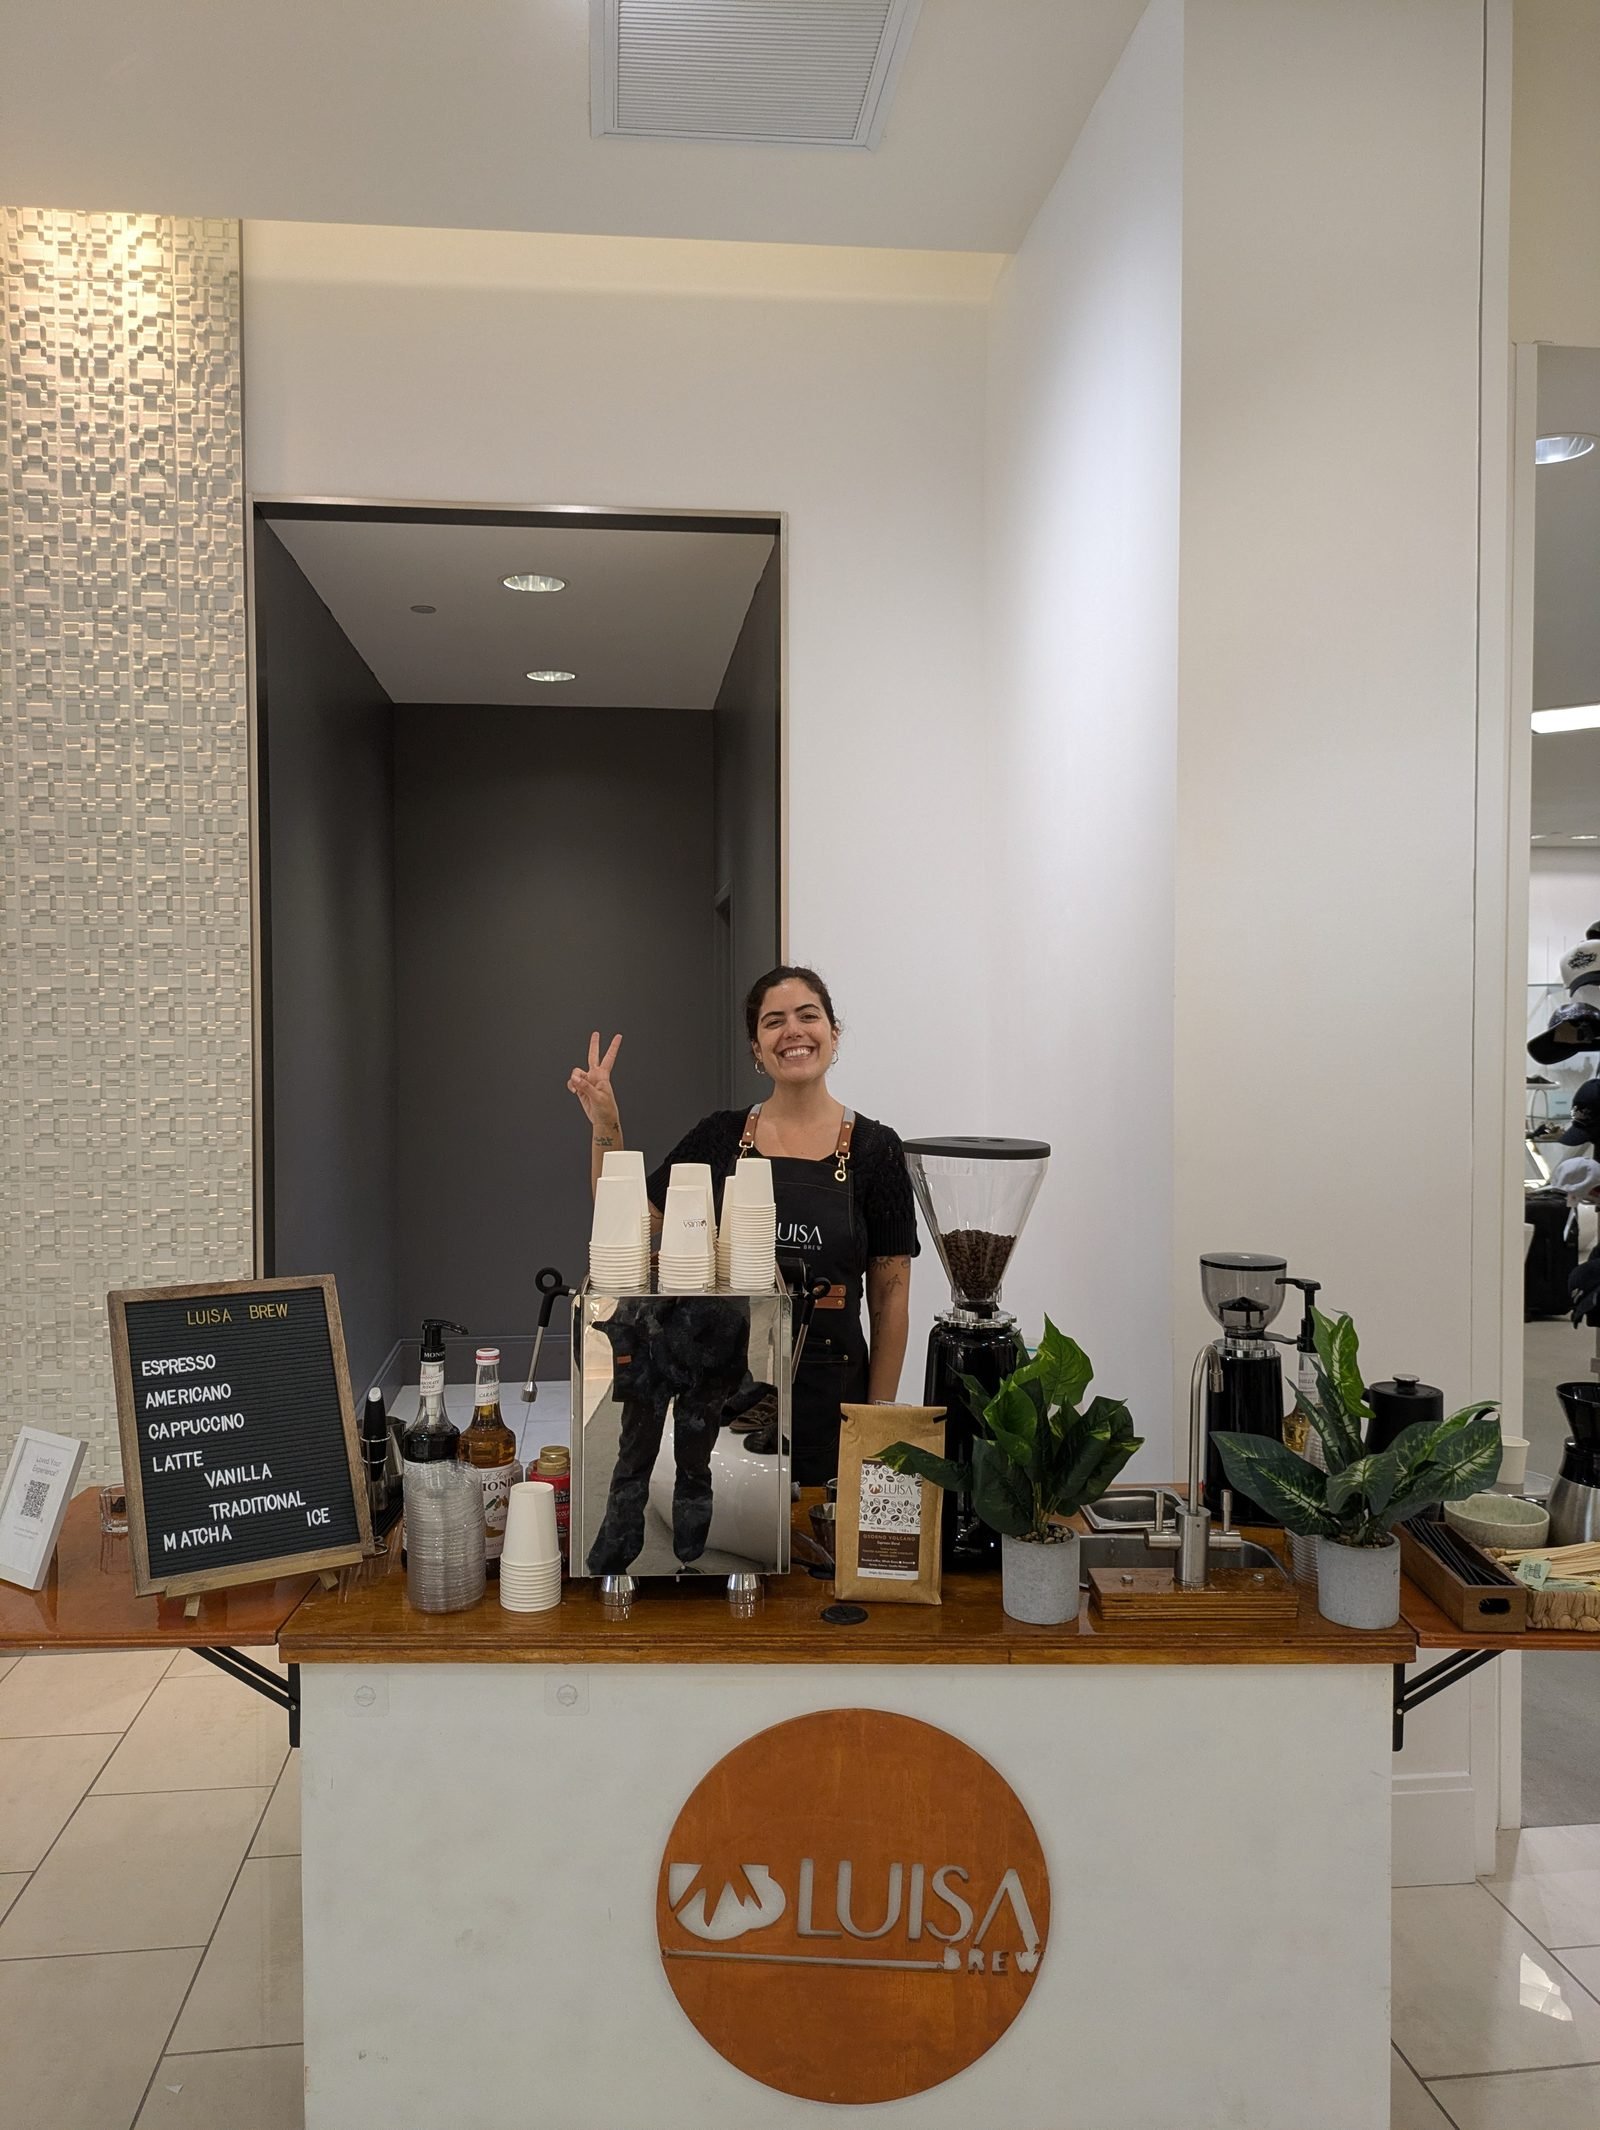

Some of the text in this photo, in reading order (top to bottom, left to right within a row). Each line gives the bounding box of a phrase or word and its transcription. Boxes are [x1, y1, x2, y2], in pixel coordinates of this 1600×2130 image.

[776, 1222, 823, 1245] UISA
[187, 1303, 288, 1325] LUISA BREW
[141, 1353, 216, 1377] ESPRESSO
[145, 1383, 232, 1410] AMERICANO
[148, 1412, 245, 1440] CAPPUCCINO
[152, 1450, 204, 1473] LATTE
[204, 1463, 273, 1489] VANILLA
[482, 1477, 514, 1491] ONIN
[884, 1484, 913, 1496] LUISA
[208, 1490, 306, 1521] TRADITIONAL
[306, 1507, 331, 1527] ICE
[163, 1524, 232, 1552] MATCHA
[797, 1858, 1040, 1947] LUISA
[943, 1947, 1046, 1975] BREW
